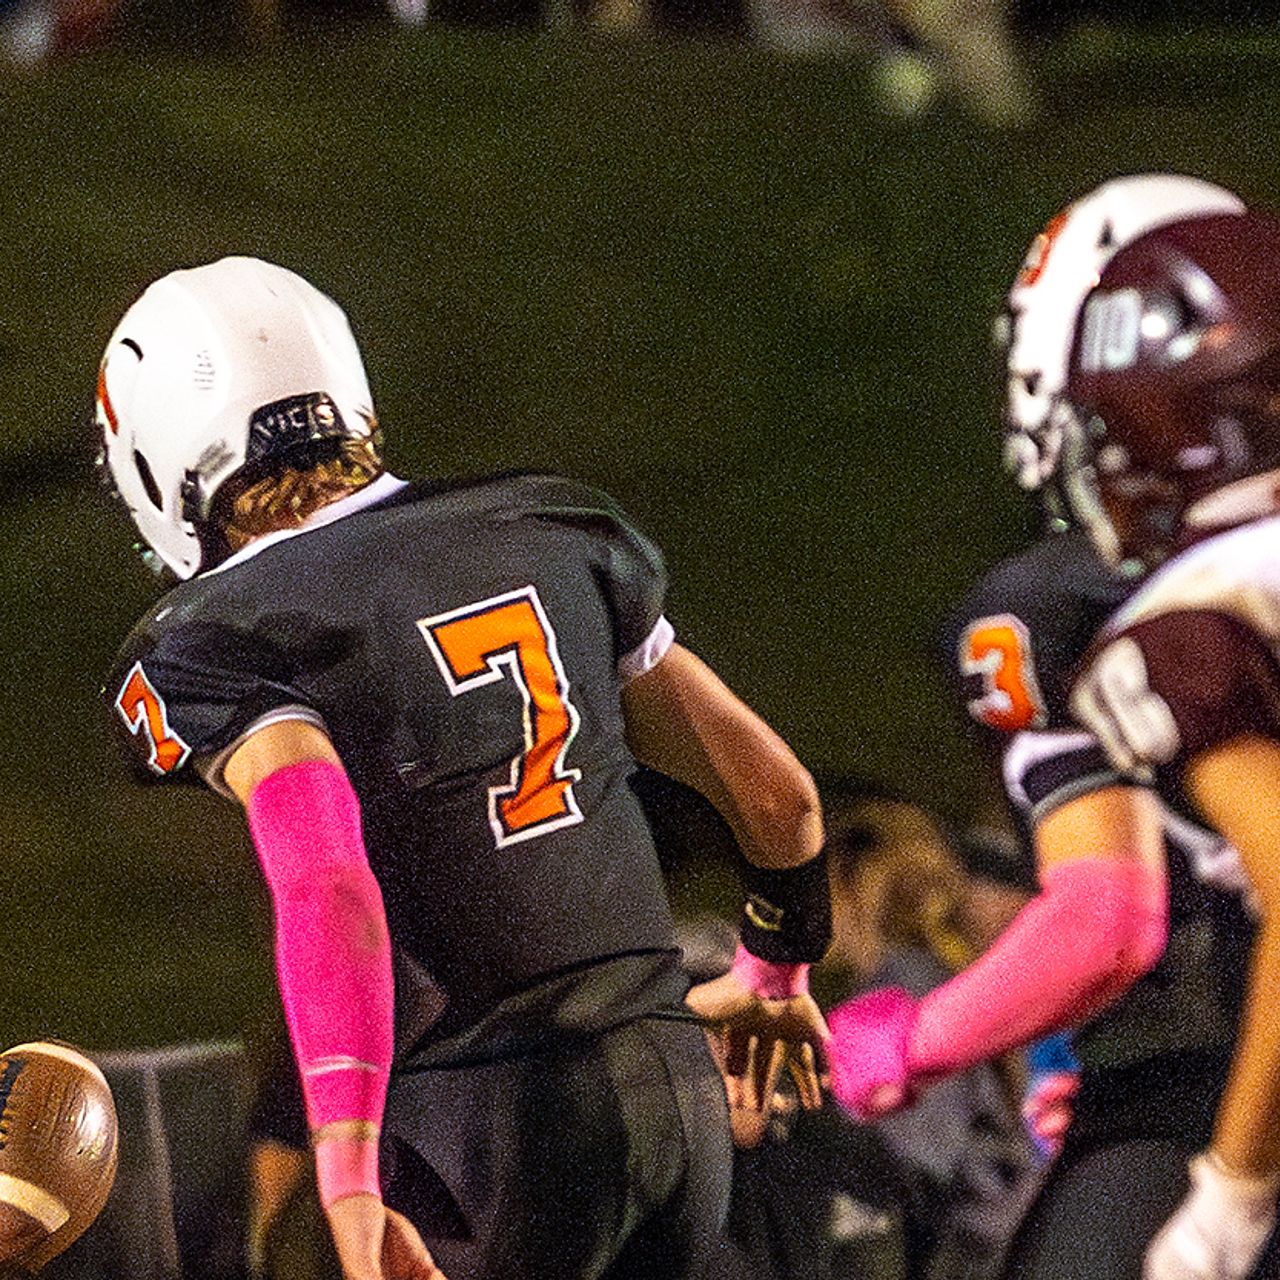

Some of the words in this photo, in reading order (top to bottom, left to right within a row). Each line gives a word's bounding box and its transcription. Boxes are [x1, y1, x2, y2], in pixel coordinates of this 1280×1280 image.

[116, 662, 191, 776] 7
[420, 585, 584, 849] 7
[960, 613, 1045, 732] 3
